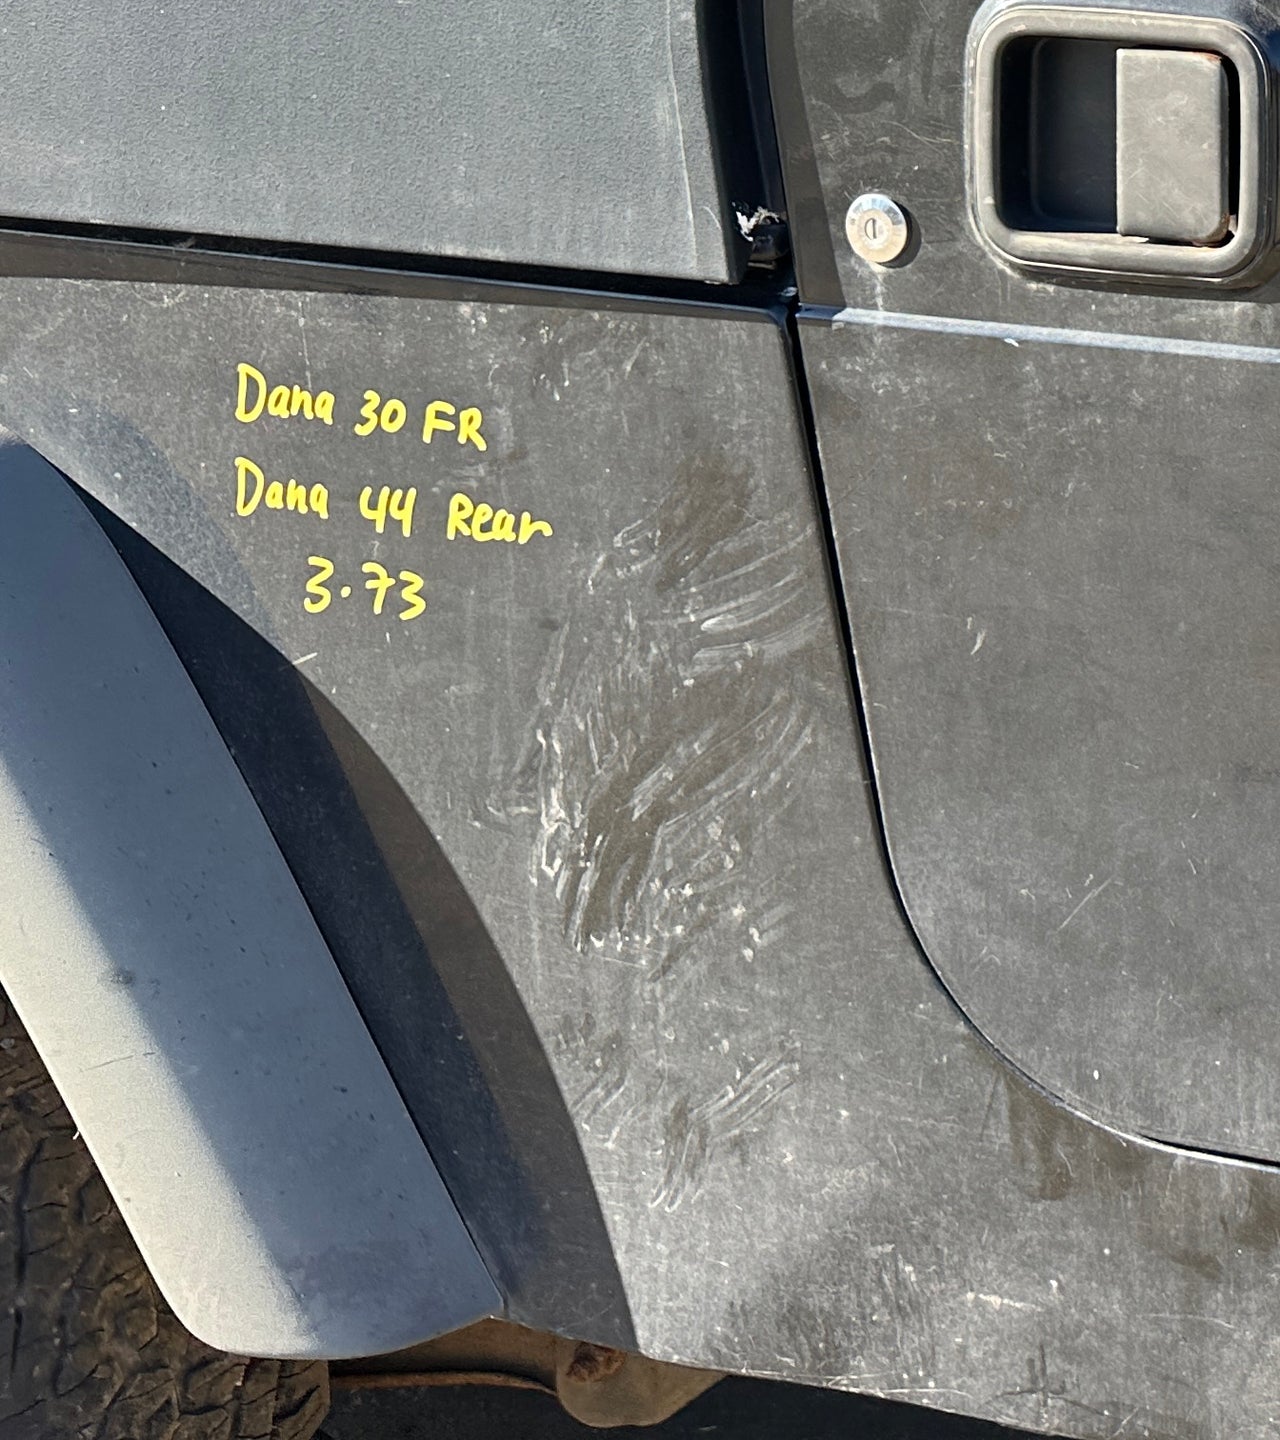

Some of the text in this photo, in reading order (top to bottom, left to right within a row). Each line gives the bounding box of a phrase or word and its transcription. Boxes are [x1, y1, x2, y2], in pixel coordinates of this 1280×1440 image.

[234, 362, 488, 452] Dana 30 FR
[234, 456, 554, 545] Dana 44 Rear
[303, 555, 428, 621] 3.73
